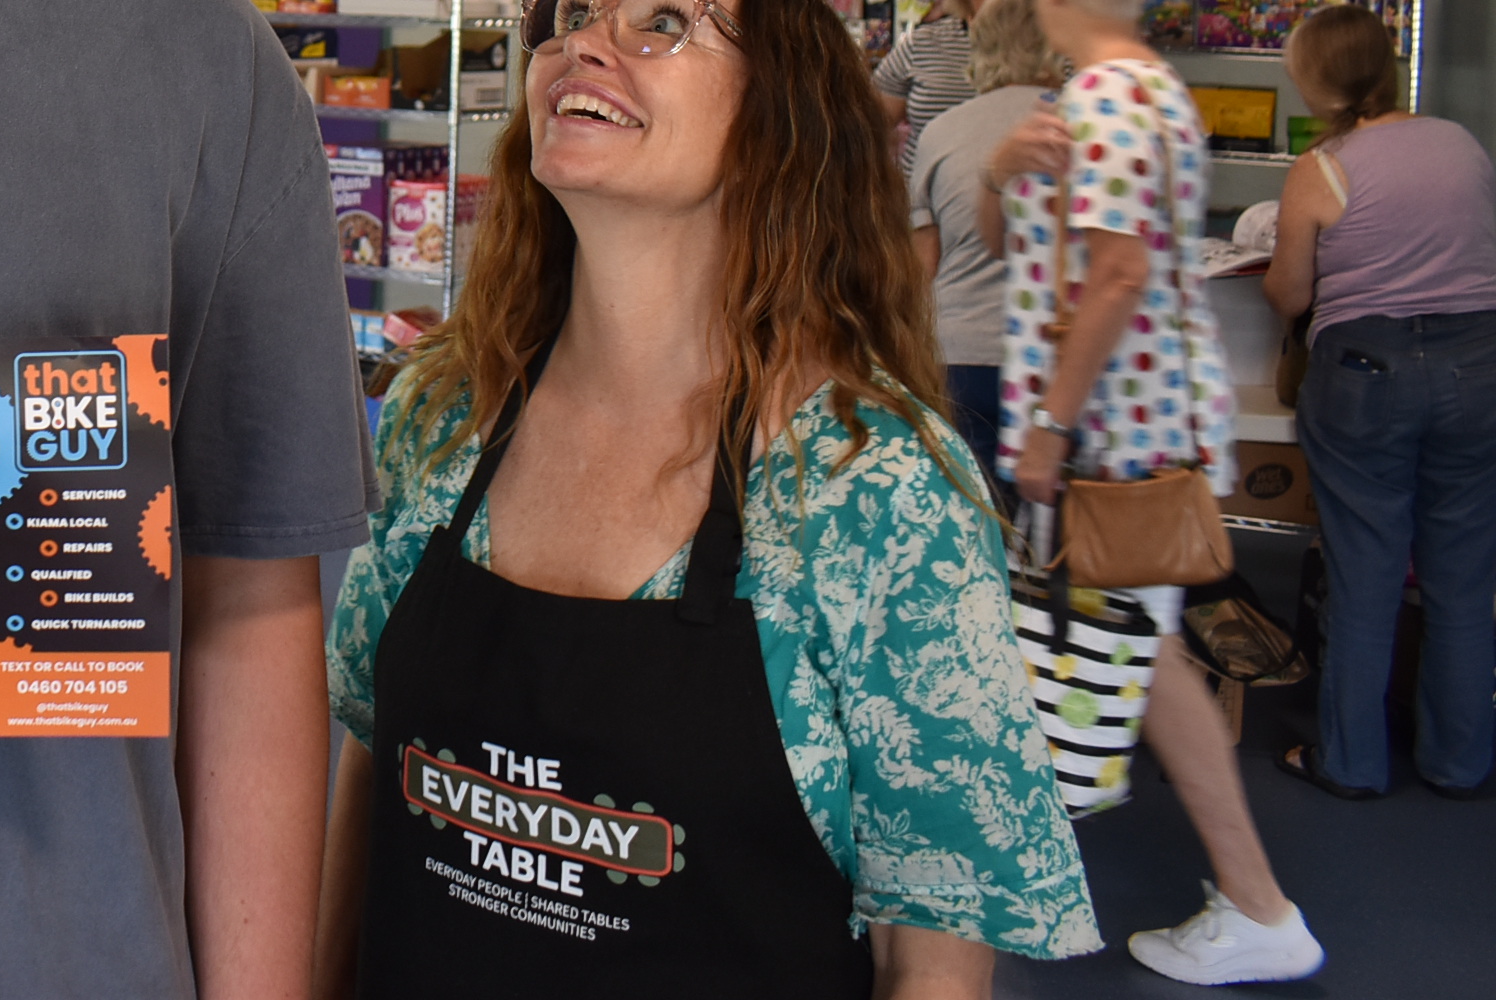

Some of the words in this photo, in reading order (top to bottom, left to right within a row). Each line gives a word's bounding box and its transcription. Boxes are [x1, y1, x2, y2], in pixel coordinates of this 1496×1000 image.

[24, 362, 117, 395] that
[24, 395, 118, 430] BIKE
[27, 428, 117, 462] GUY
[62, 489, 126, 501] SERVICING
[26, 517, 68, 528] KIAMA
[69, 517, 109, 528] LOCAL
[63, 542, 113, 553] REPAIRS
[31, 569, 93, 581] QUALIFIED
[64, 592, 92, 603] BIKE
[92, 592, 135, 603] BUILDS
[31, 619, 70, 631] QUICK
[0, 661, 31, 672] TEXT
[33, 661, 52, 672] OR
[54, 661, 86, 672] CALL
[87, 661, 106, 672] TO
[107, 661, 144, 672] BOOK
[17, 680, 61, 694] 0460
[64, 680, 96, 694] 704
[99, 680, 128, 694] 105
[36, 702, 109, 713] @thatbikeguy
[7, 716, 138, 727] www.thatbikeguy.com.au
[481, 741, 563, 791] THE
[422, 764, 639, 860] EVERYDAY
[463, 831, 584, 897] TABLE
[425, 856, 477, 891] EVERYDAY
[478, 879, 522, 905] PEOPLE
[531, 895, 579, 920] SHARED
[581, 909, 630, 931] TABLES
[449, 883, 508, 917] STRONGER
[510, 906, 596, 942] COMMUNITIES
